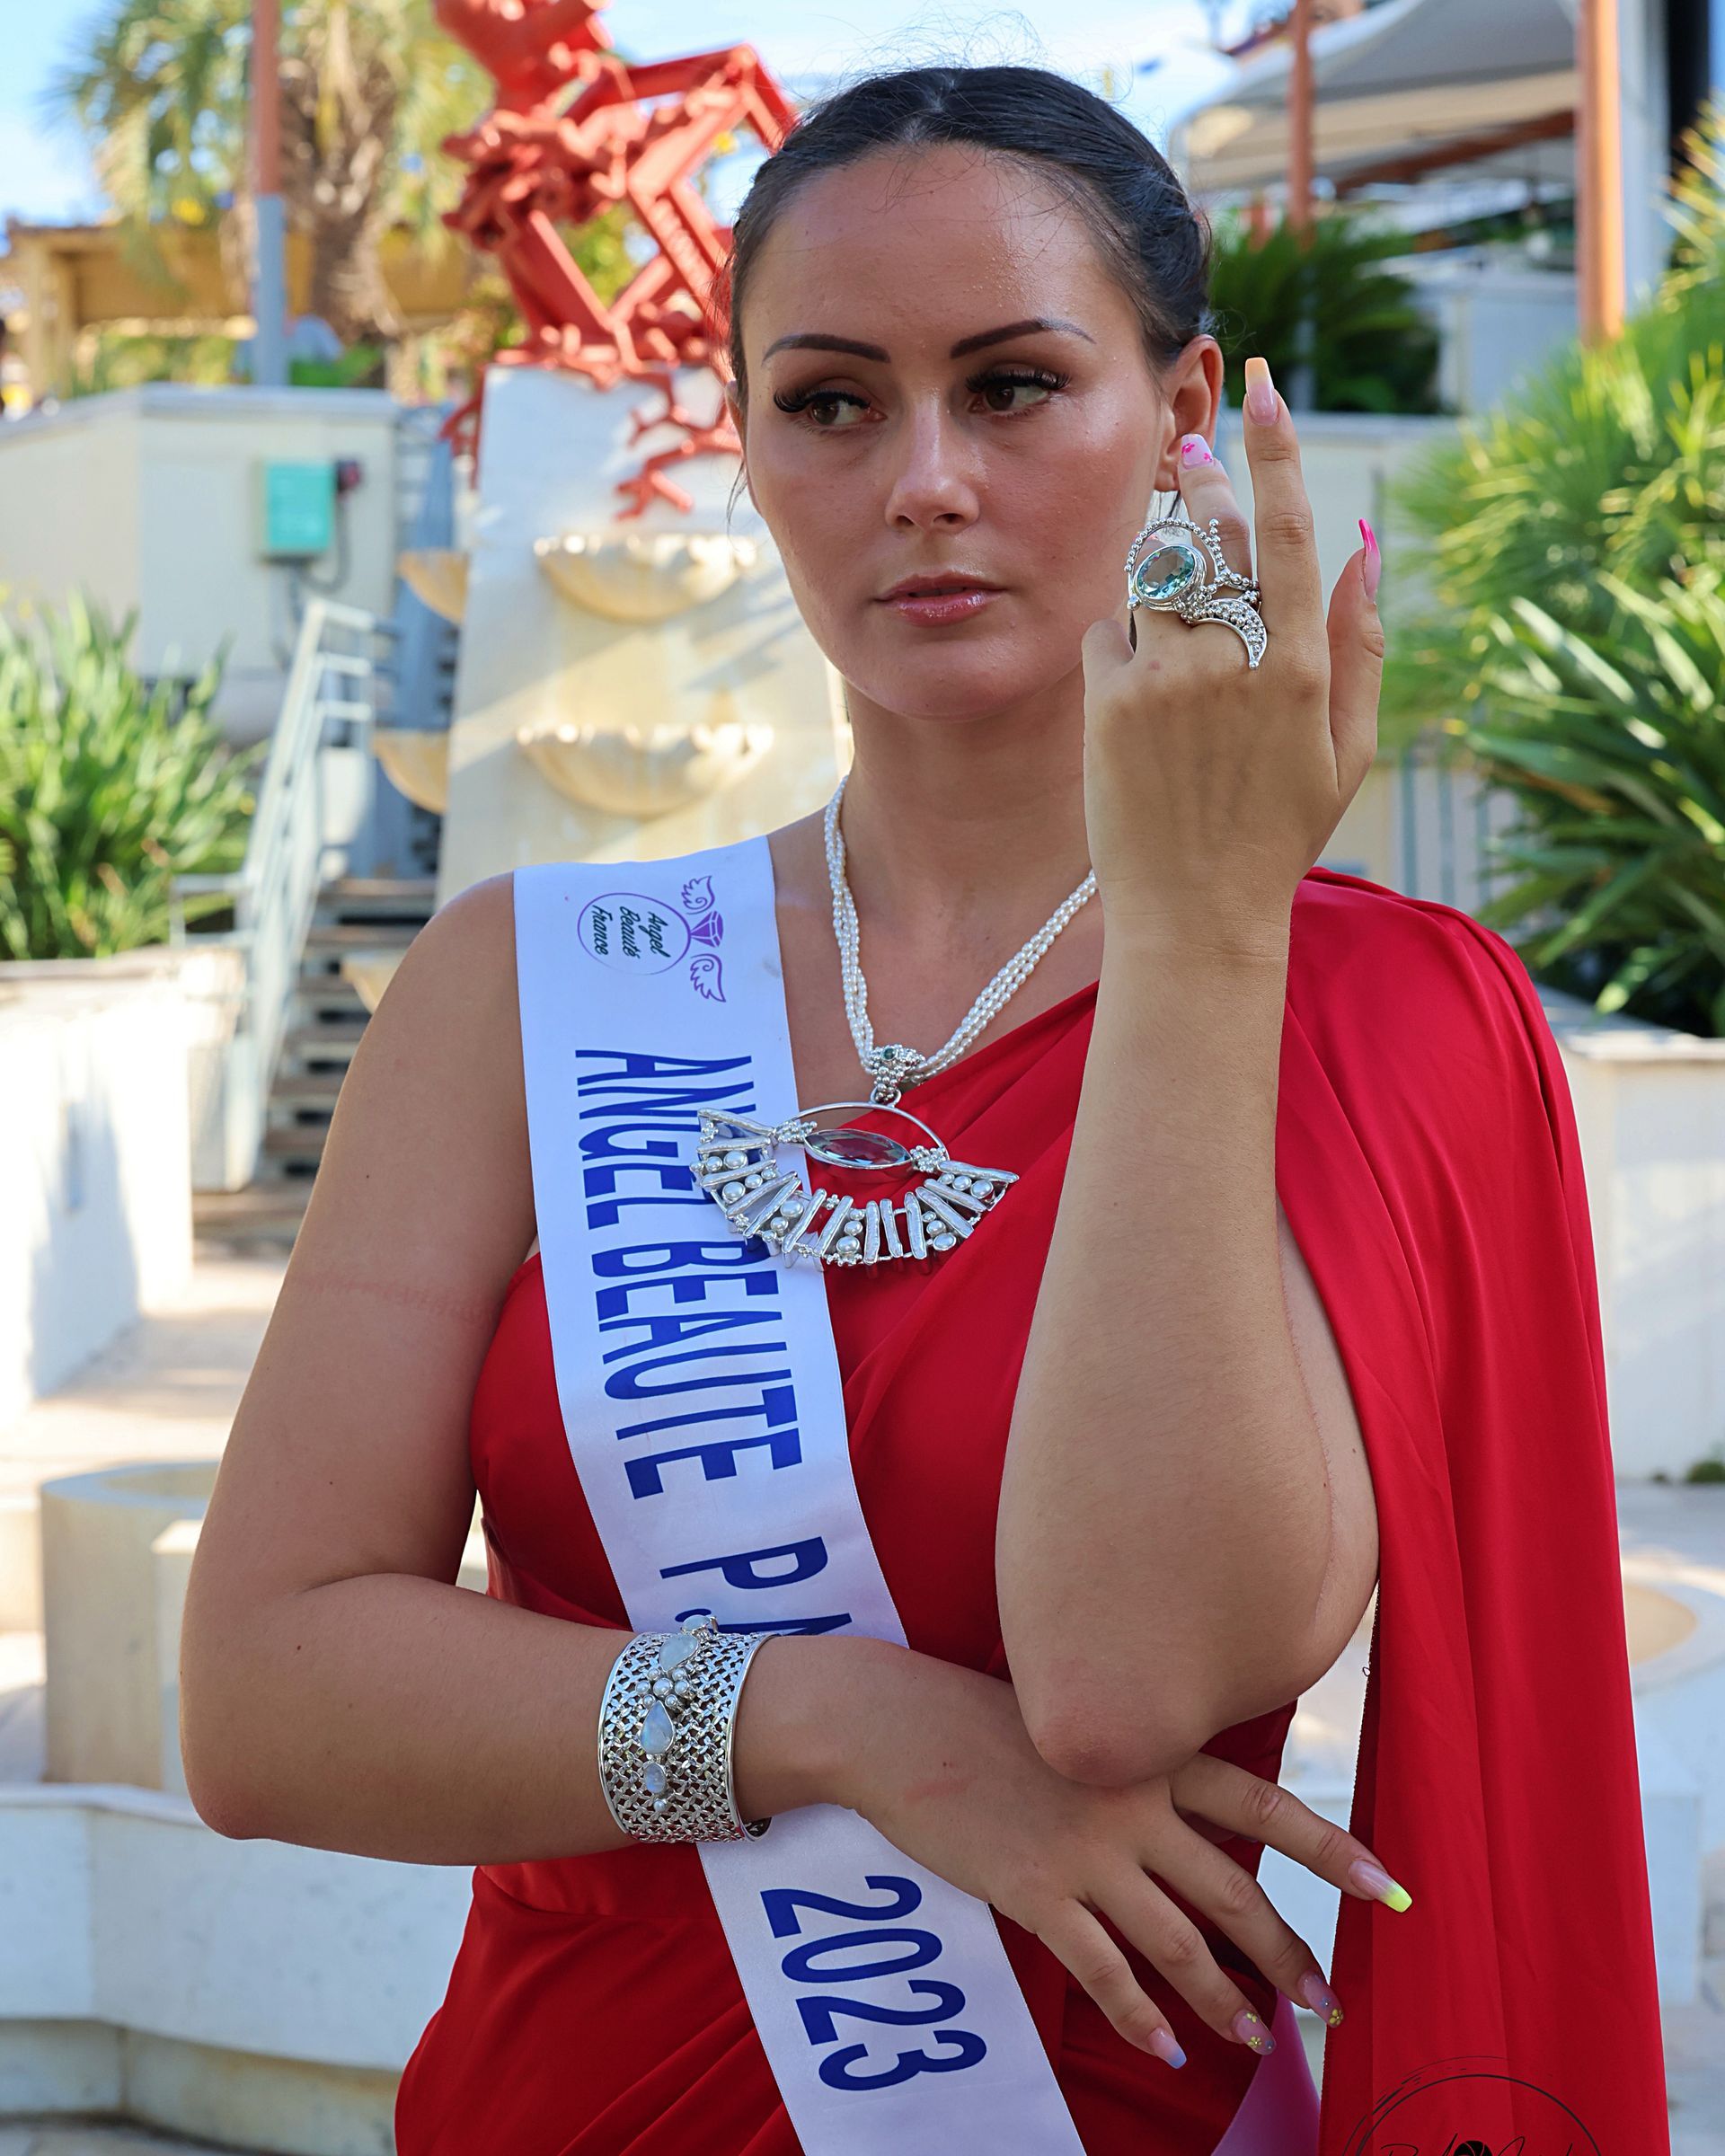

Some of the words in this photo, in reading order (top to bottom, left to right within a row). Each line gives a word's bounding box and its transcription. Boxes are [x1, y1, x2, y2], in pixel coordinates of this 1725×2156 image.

[592, 905, 614, 956] France
[619, 906, 642, 959] Beauté
[638, 911, 671, 958] Angel
[575, 1049, 760, 1231] ANGEL
[591, 1237, 803, 1500] BEAUTE
[760, 1875, 987, 2091] 2023
